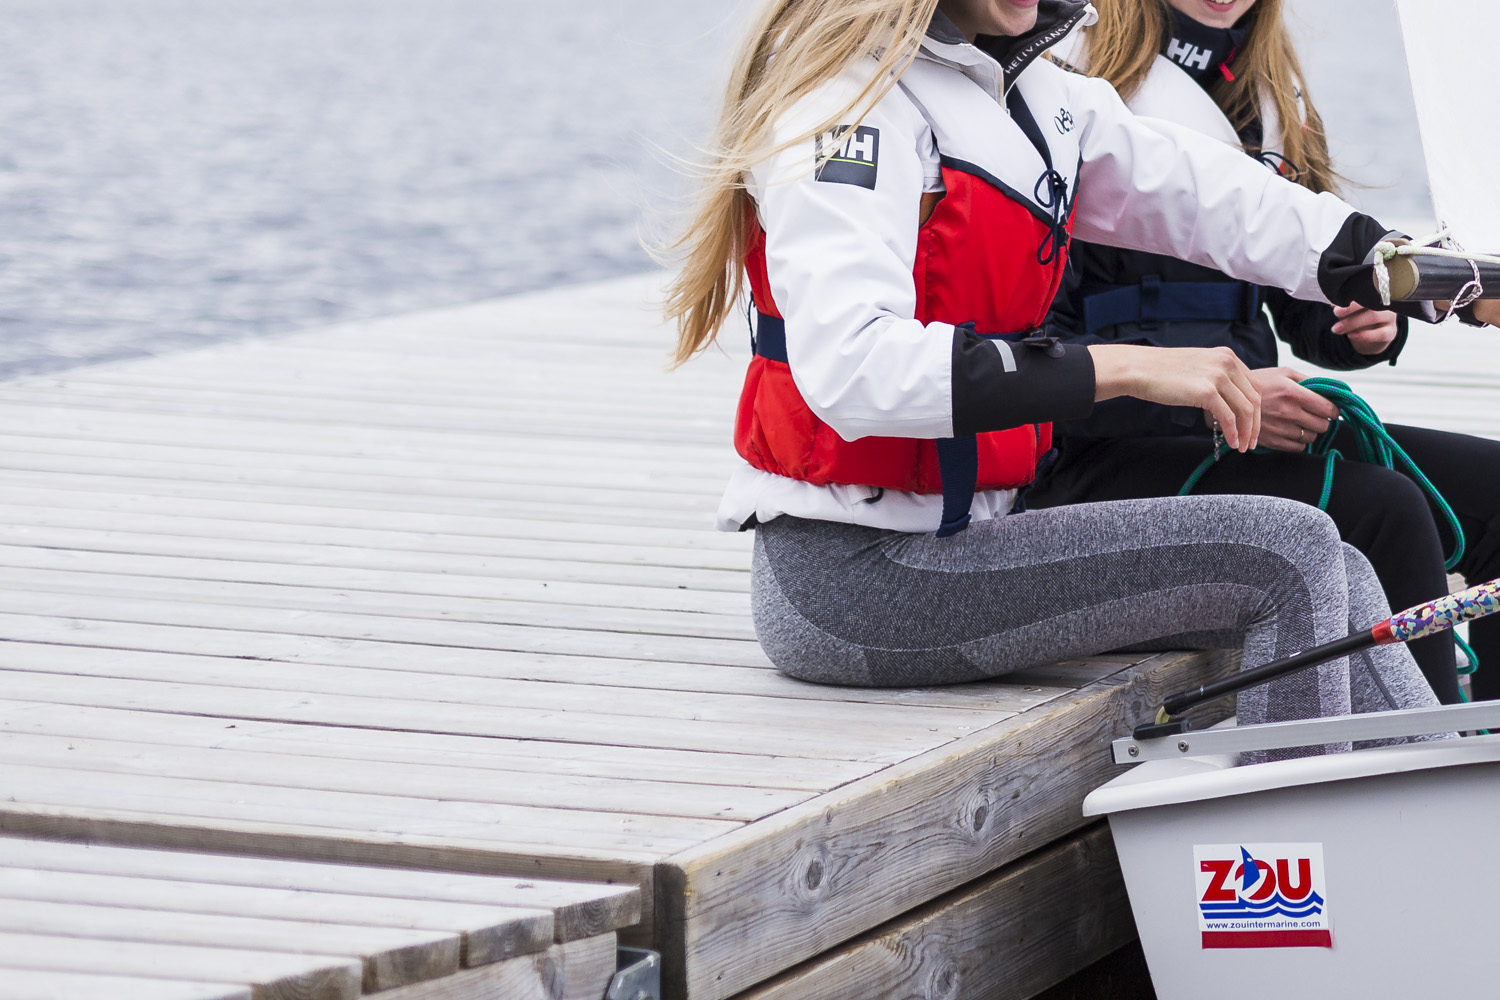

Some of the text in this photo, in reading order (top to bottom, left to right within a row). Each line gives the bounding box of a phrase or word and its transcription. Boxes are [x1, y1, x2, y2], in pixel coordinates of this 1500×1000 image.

[1166, 37, 1212, 70] HH
[821, 131, 874, 162] HH
[1199, 858, 1312, 901] ZOU
[1206, 919, 1321, 930] www.zouintermarine.com
